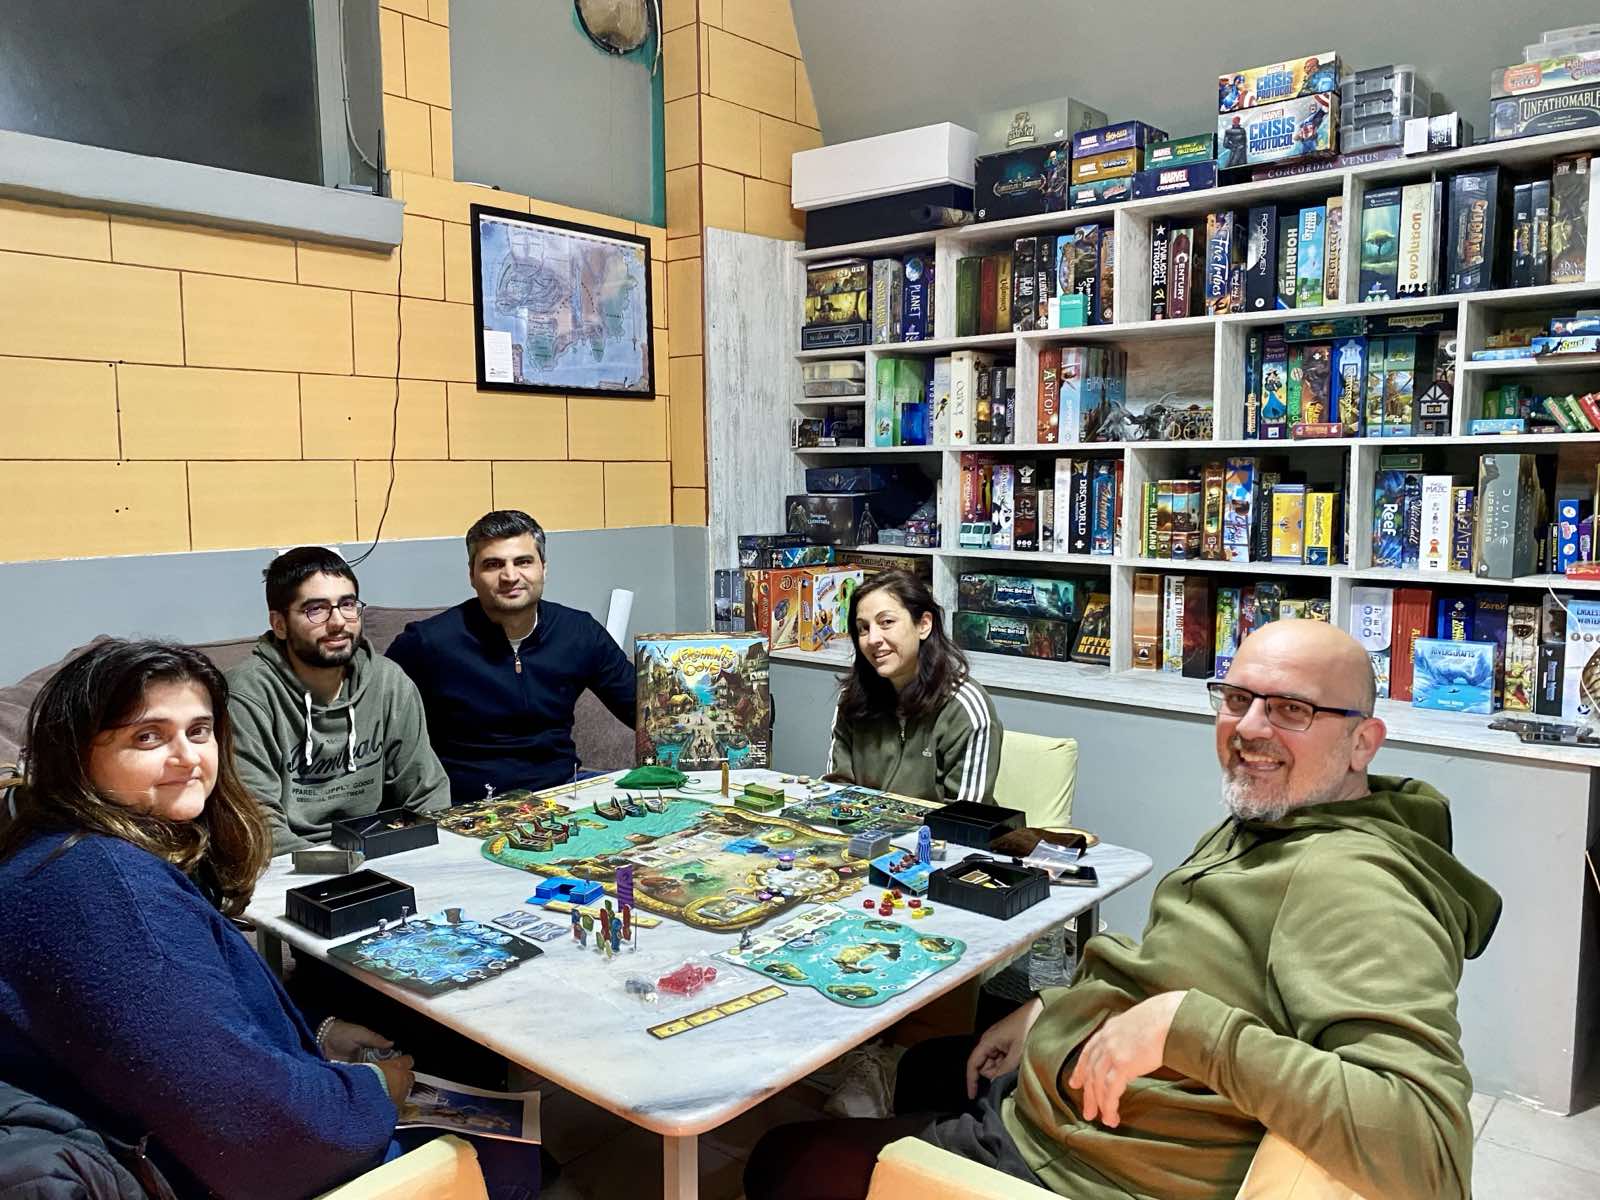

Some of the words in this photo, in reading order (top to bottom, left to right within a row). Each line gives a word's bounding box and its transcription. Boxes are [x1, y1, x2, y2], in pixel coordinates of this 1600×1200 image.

[1257, 70, 1293, 91] CRISIS
[1523, 89, 1600, 120] UNFATHOMABLE
[1249, 116, 1296, 140] CRISIS
[1249, 133, 1295, 153] PROTOCOL
[1267, 161, 1334, 178] CONCORDIA
[1341, 152, 1379, 166] VENUS
[1175, 252, 1187, 301] CENTURY
[1285, 228, 1298, 296] HORRIFIED
[909, 284, 921, 320] PLANET
[1078, 478, 1087, 536] DISCWORLD
[1382, 503, 1398, 537] Reef
[1149, 507, 1157, 550] ALTIPLANO
